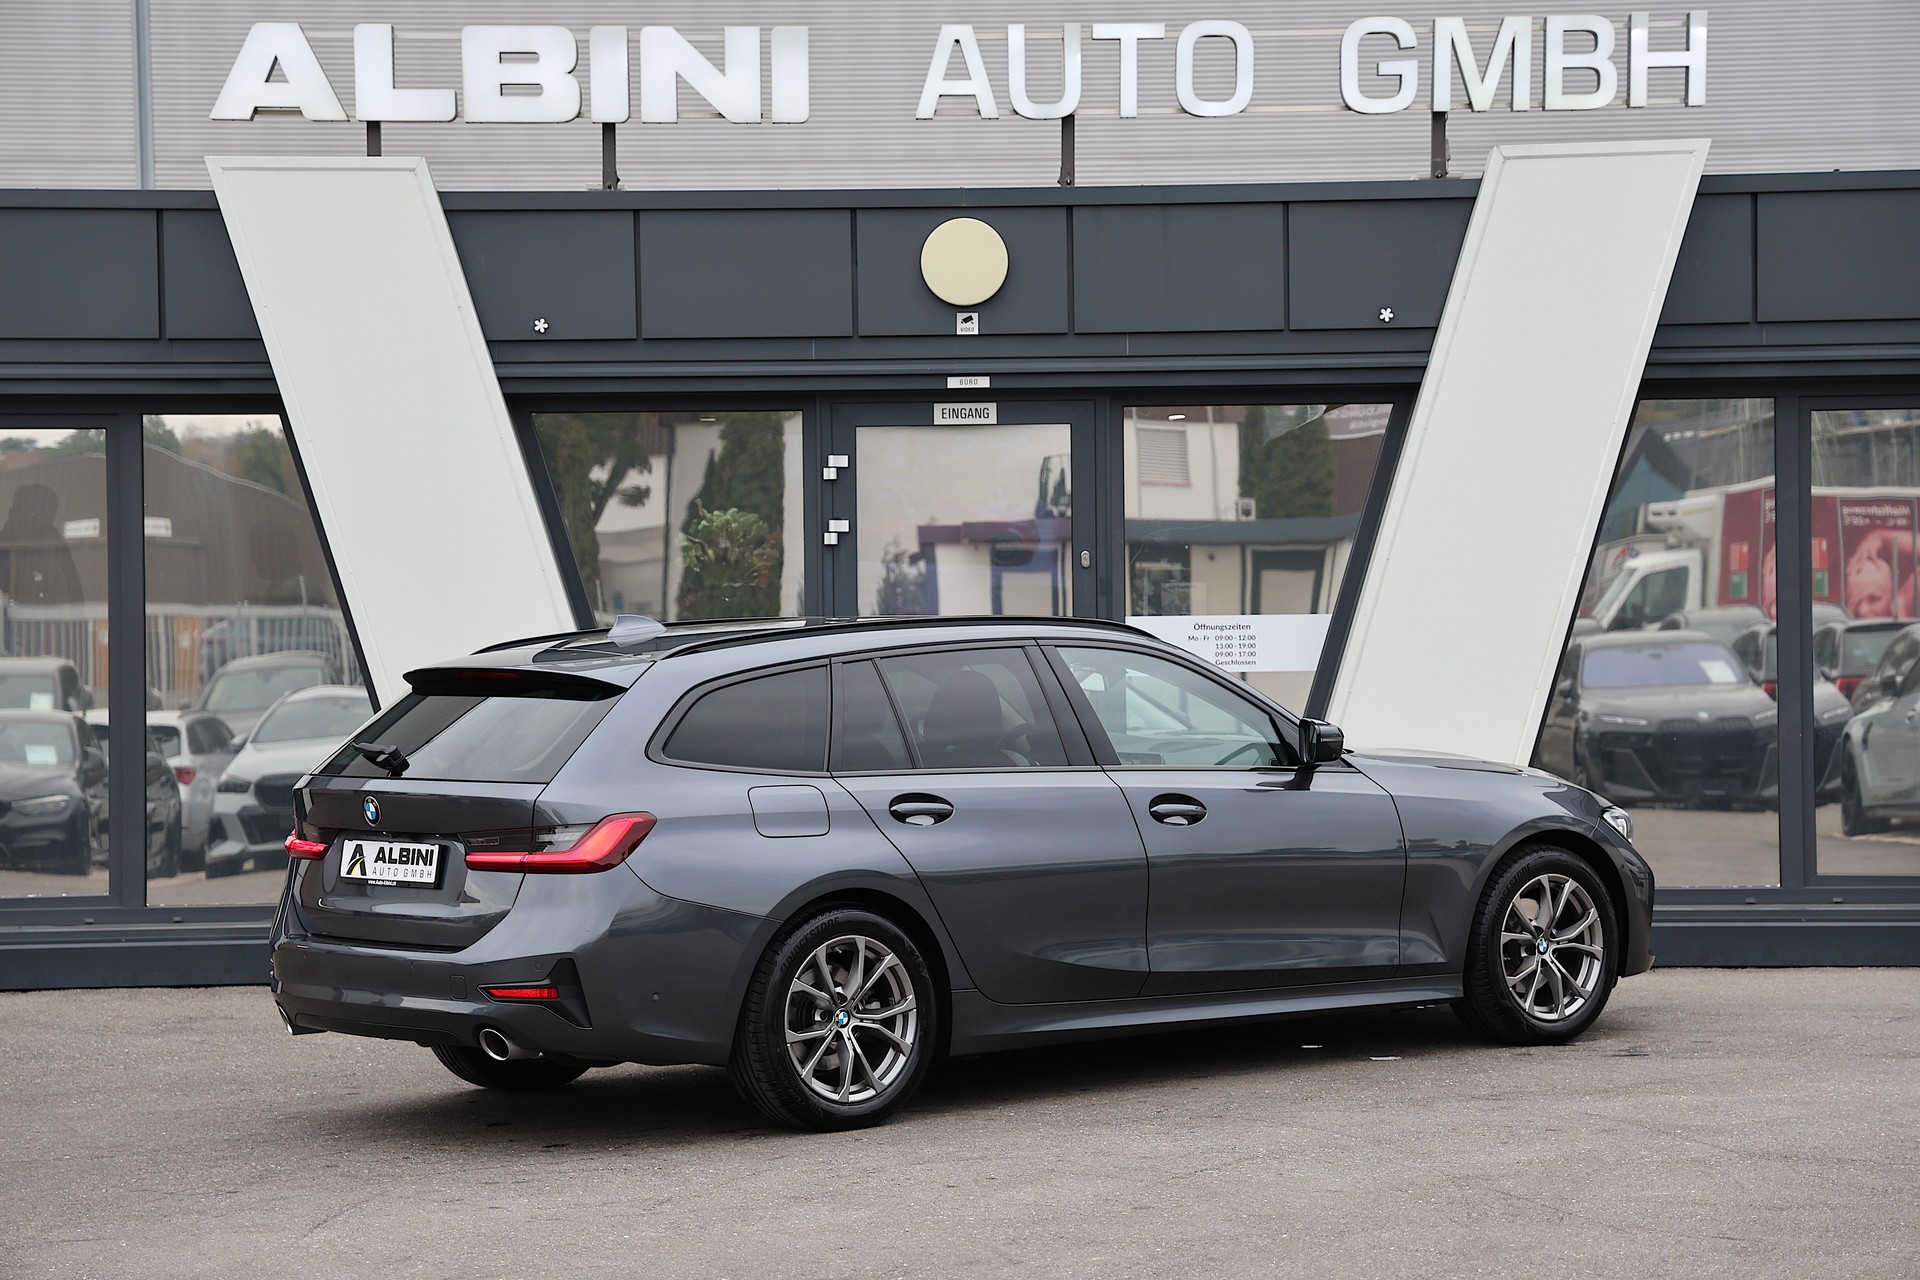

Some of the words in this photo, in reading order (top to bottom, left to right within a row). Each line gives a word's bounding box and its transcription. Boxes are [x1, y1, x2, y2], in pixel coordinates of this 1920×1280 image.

[209, 22, 809, 123] ALBINI
[915, 20, 1254, 120] AUTO
[1339, 10, 1708, 115] GMBH
[959, 377, 978, 386] BÜRO
[941, 407, 990, 419] EINGANG
[1193, 622, 1251, 631] Öffnungszeiten
[374, 847, 434, 866] ALBINI
[372, 867, 399, 877] AUTO
[403, 868, 432, 879] GMBH
